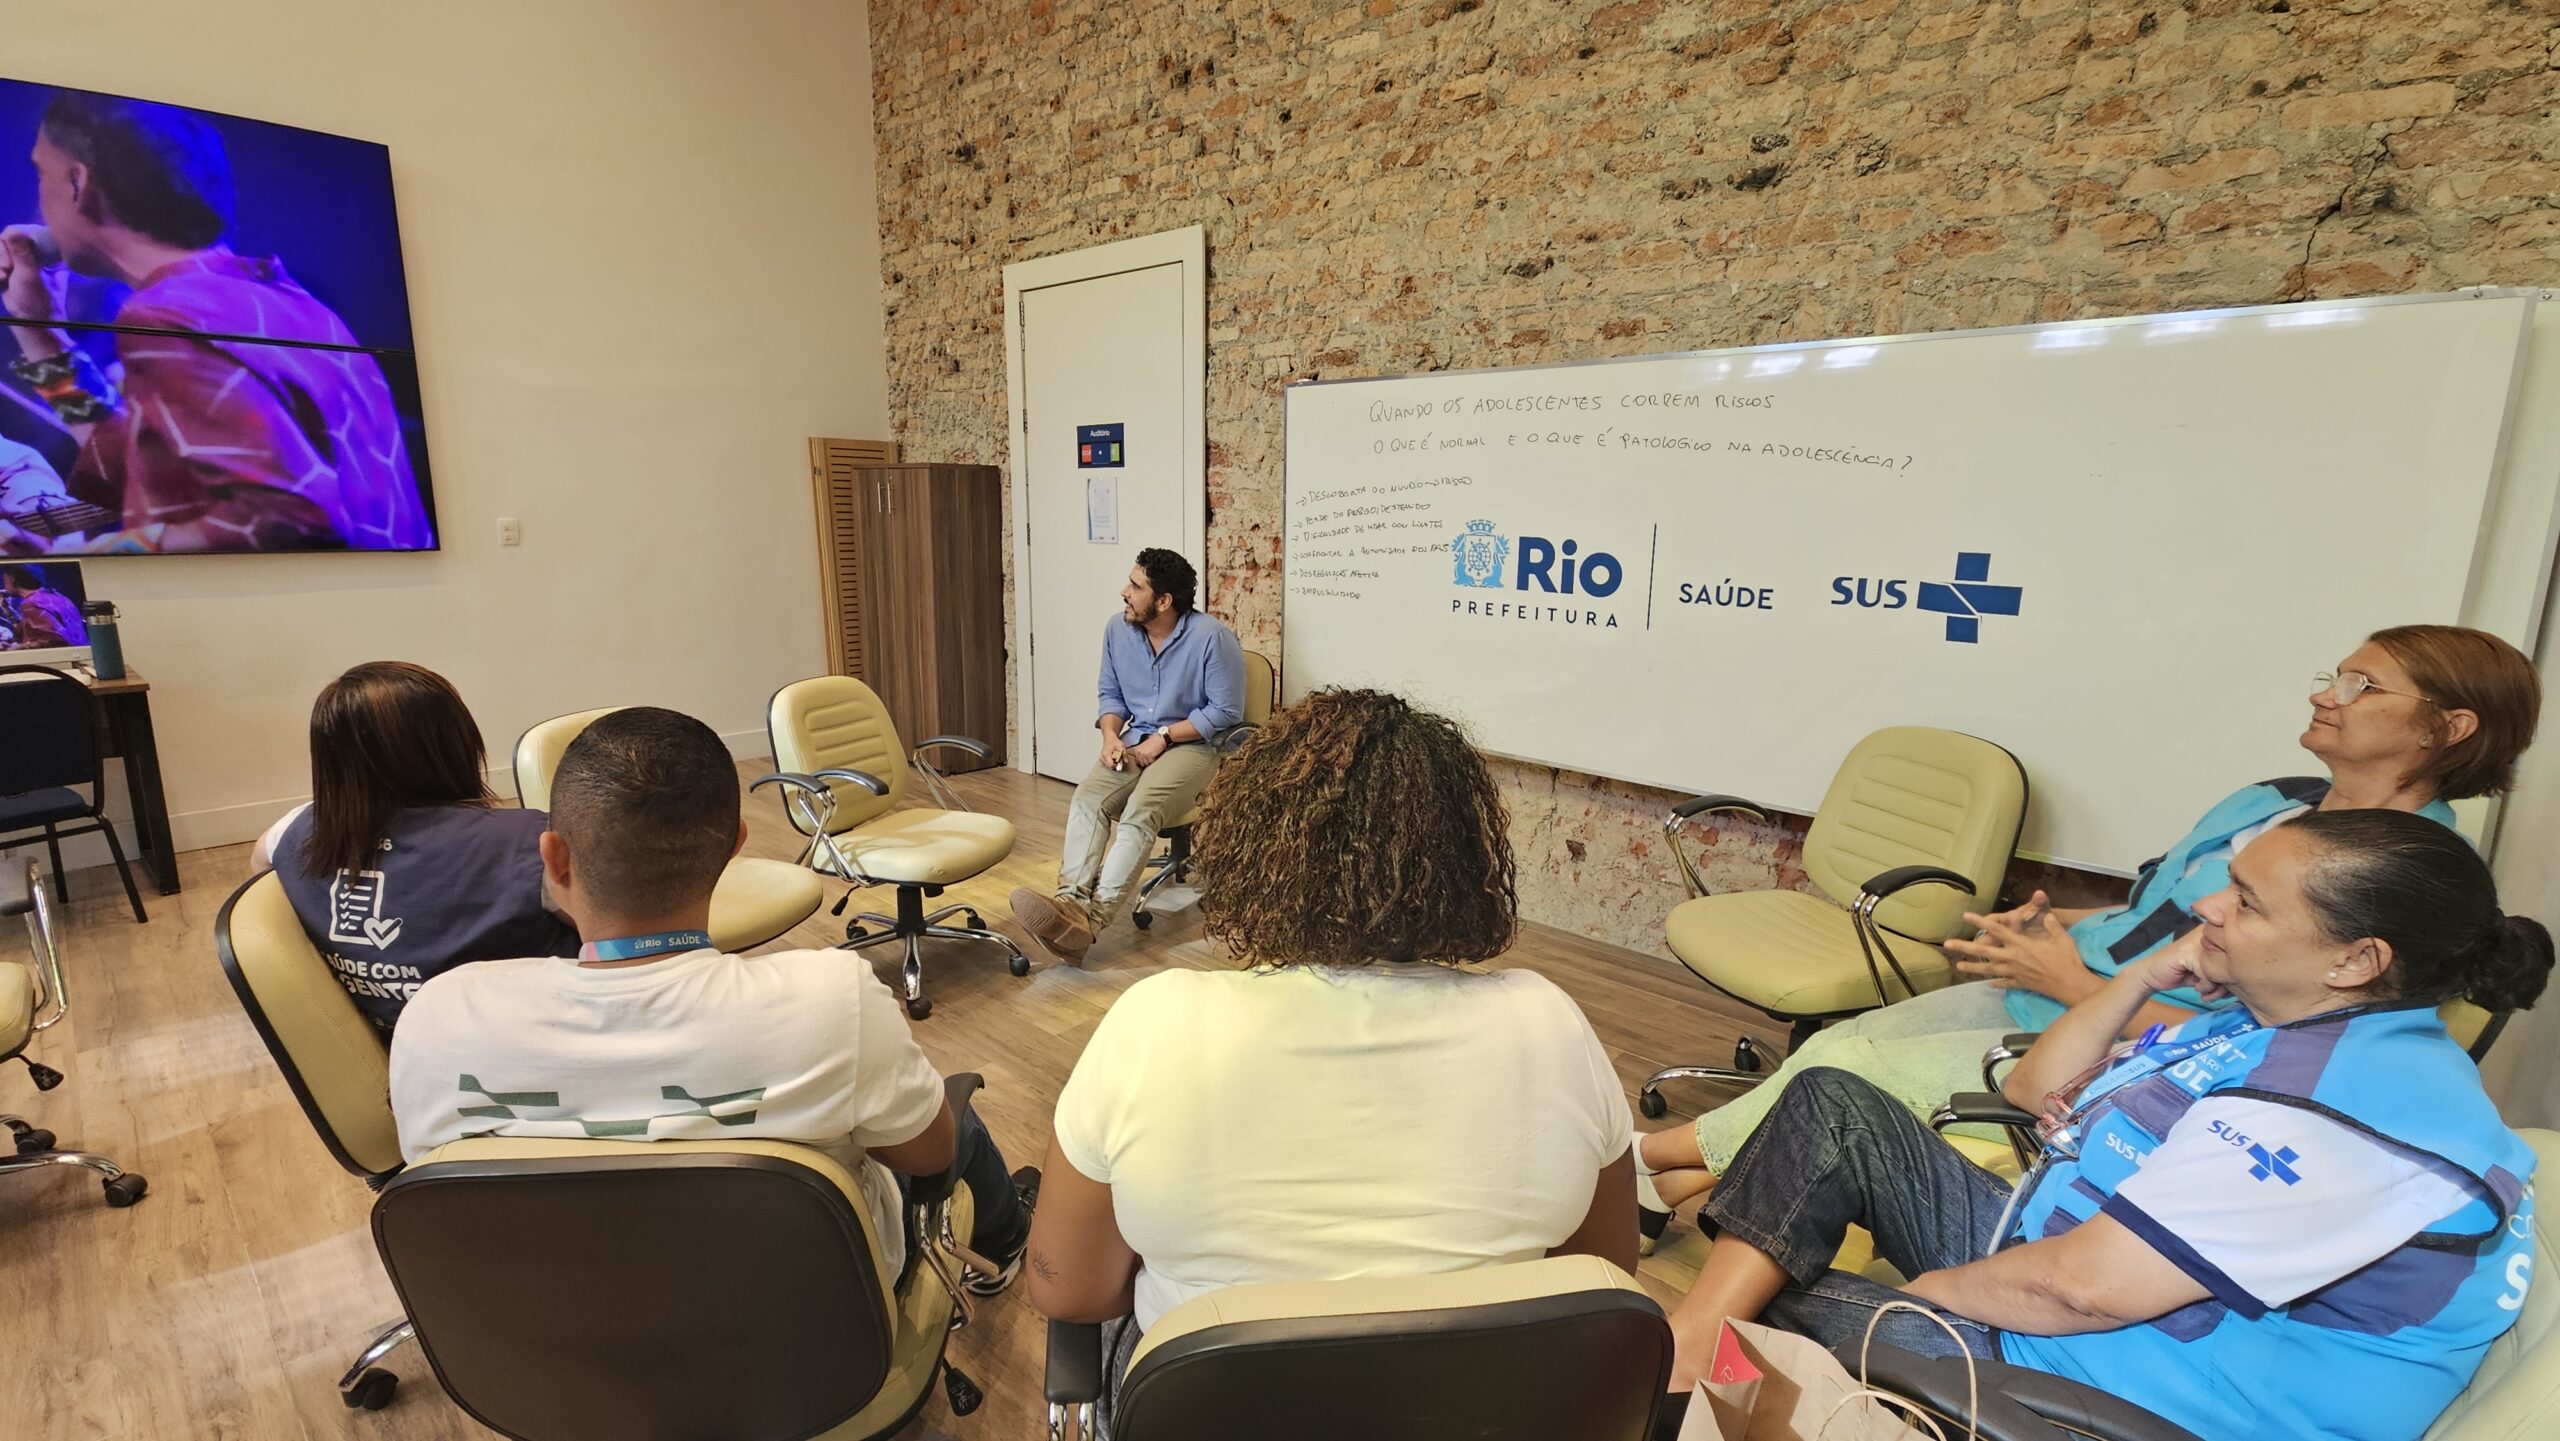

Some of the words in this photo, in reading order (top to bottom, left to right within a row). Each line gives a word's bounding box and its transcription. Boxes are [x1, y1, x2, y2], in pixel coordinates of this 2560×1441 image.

[1370, 400, 1433, 423] QUANDO
[1443, 397, 1464, 414] OS
[1473, 395, 1602, 414] ADOLESCENTES
[1621, 393, 1700, 408] CORREM
[1374, 440, 1384, 454] O
[1391, 438, 1416, 452] QUE
[1440, 437, 1486, 449] NORMAL
[1508, 435, 1517, 446] E
[1527, 433, 1539, 443] O
[1547, 432, 1584, 444] QUE
[1727, 442, 1751, 453] NA
[1516, 536, 1623, 597] Rio
[1679, 578, 1774, 610] SAÚDE
[1831, 576, 1908, 609] SUS
[1452, 599, 1618, 628] PREFEITURA
[645, 940, 662, 948] Rio
[668, 933, 701, 947] SAÚDE
[325, 952, 367, 977] AÚDE
[371, 962, 421, 979] COM
[2192, 1034, 2228, 1051] SAÚDE
[2105, 1132, 2136, 1161] SUS
[2207, 1120, 2252, 1147] SUS
